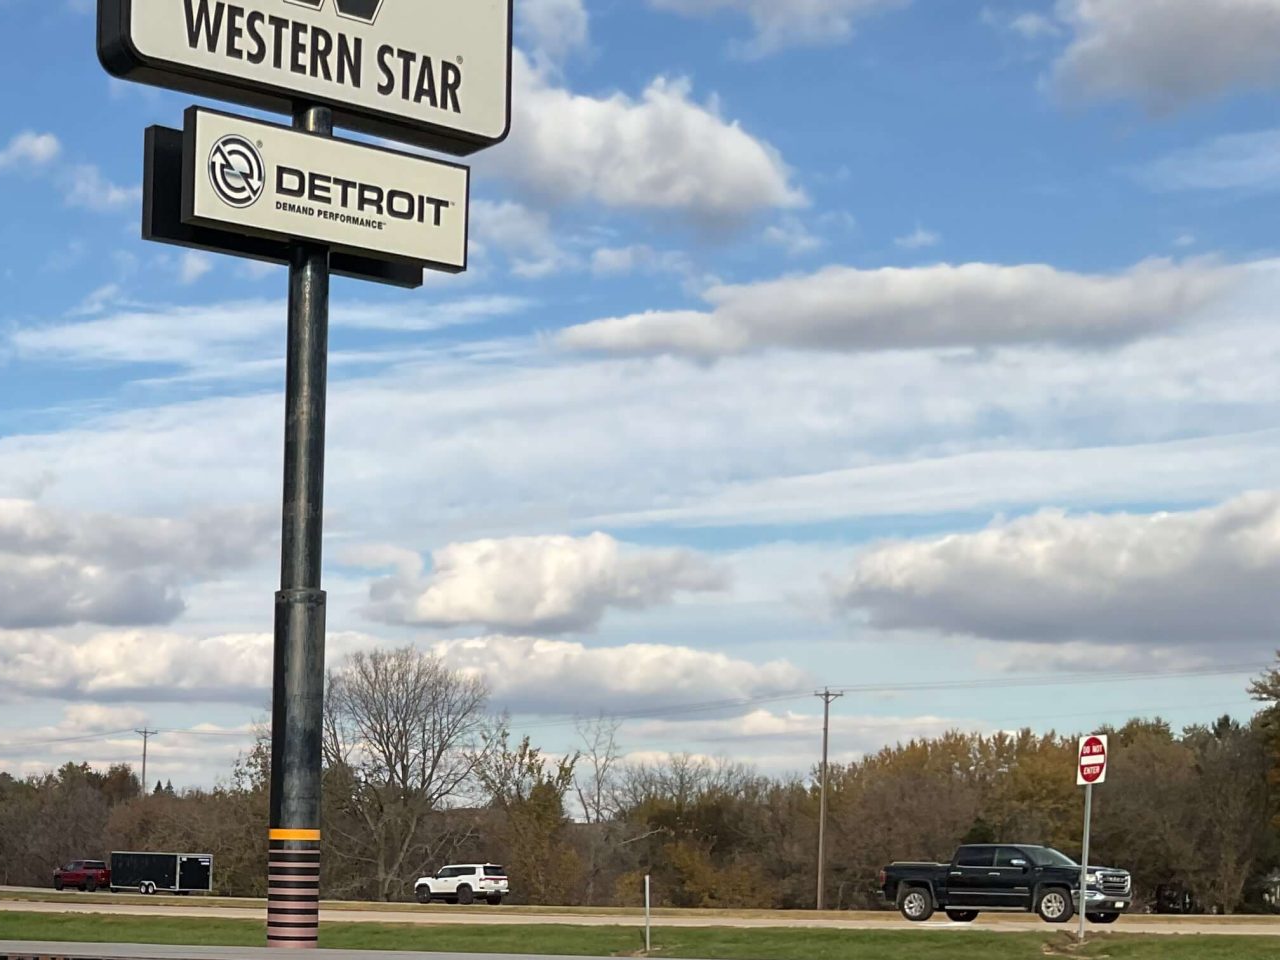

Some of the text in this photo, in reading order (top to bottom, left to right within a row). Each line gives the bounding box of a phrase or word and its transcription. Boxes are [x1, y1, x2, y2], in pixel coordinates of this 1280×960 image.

[183, 0, 461, 113] WESTERN STAR
[276, 165, 449, 226] DETROIT
[276, 201, 383, 230] DEMAND PERFORMANCE
